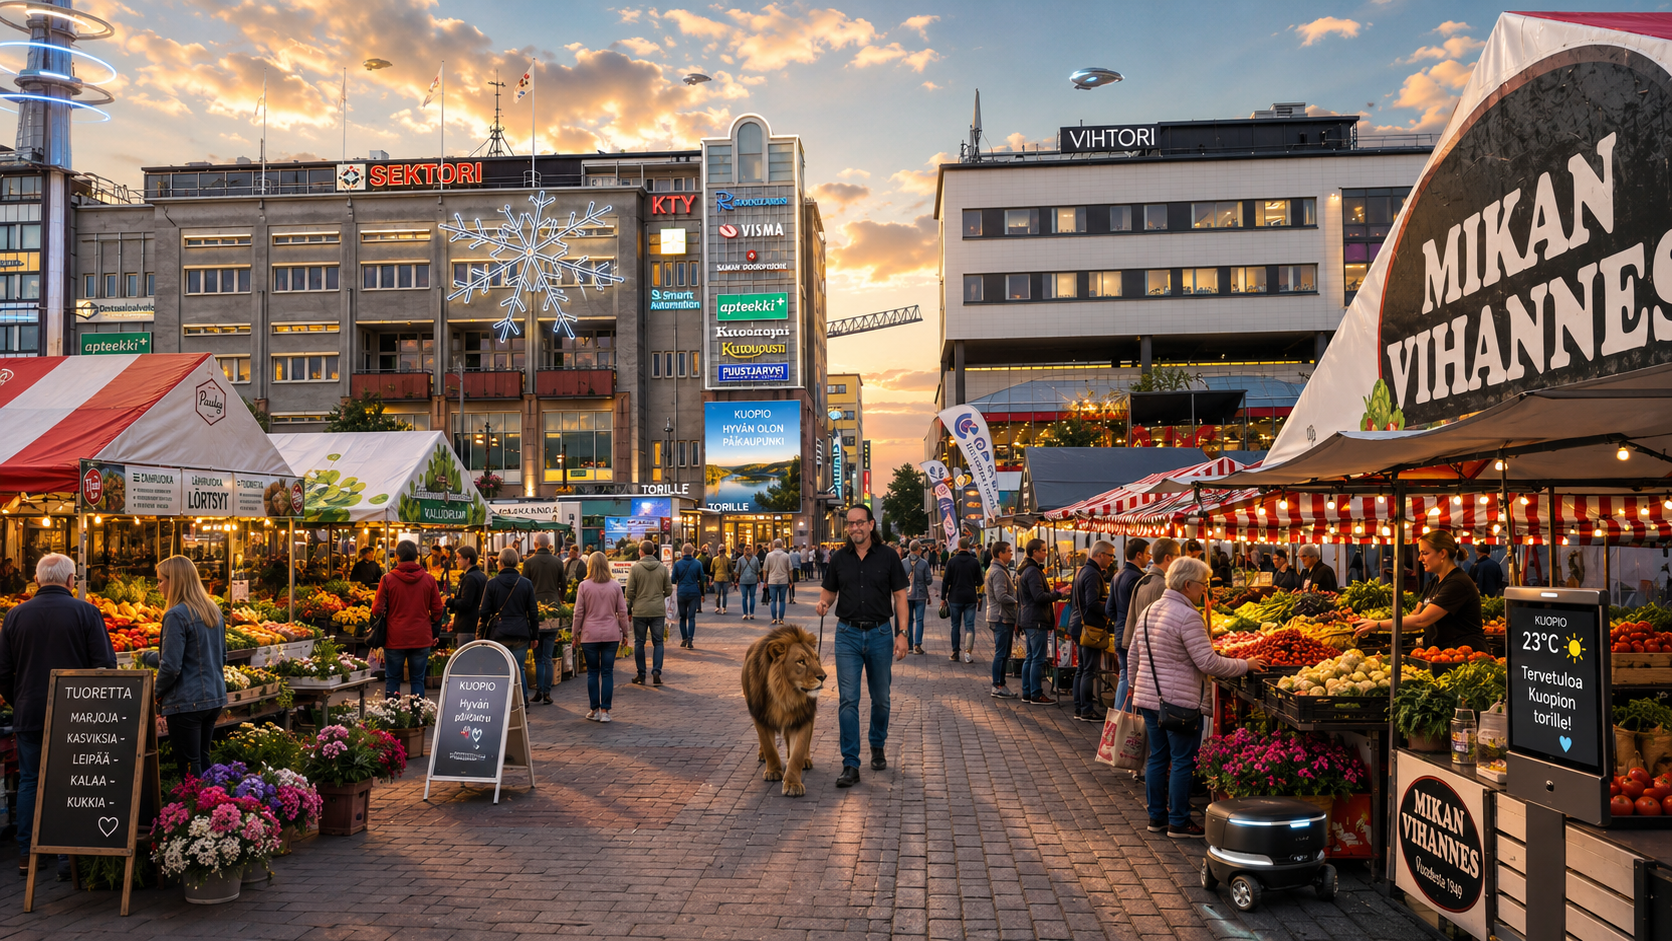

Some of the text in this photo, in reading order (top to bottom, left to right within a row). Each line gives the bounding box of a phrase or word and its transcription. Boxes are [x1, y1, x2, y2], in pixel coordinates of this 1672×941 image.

[1069, 127, 1155, 149] VIHTORI
[370, 162, 482, 186] SEKTORI
[652, 195, 695, 214] KTY
[741, 222, 784, 237] VISMA
[1422, 131, 1617, 315] MIKAN
[734, 409, 771, 419] KUOPIO
[757, 424, 784, 433] OLON
[641, 483, 689, 495] TORILLE
[708, 502, 749, 512] TORILLE
[1535, 615, 1567, 628] KUOPIO
[1522, 631, 1559, 654] 23°C
[1521, 665, 1583, 690] Tervetuloa
[65, 686, 132, 699] TUORETTA
[459, 681, 496, 691] KUOPIO
[1528, 686, 1576, 710] Kuopion
[70, 712, 118, 724] MARJOJA
[1533, 709, 1572, 731] torille!
[67, 733, 117, 744] KASVIKSIA
[72, 752, 110, 765] LEIPÄÄ
[70, 775, 107, 786] KALAA
[67, 797, 105, 808] KUKKIA
[1414, 788, 1465, 838] MIKAN
[1402, 812, 1480, 880] VIHANNES
[1447, 878, 1463, 900] 1949
